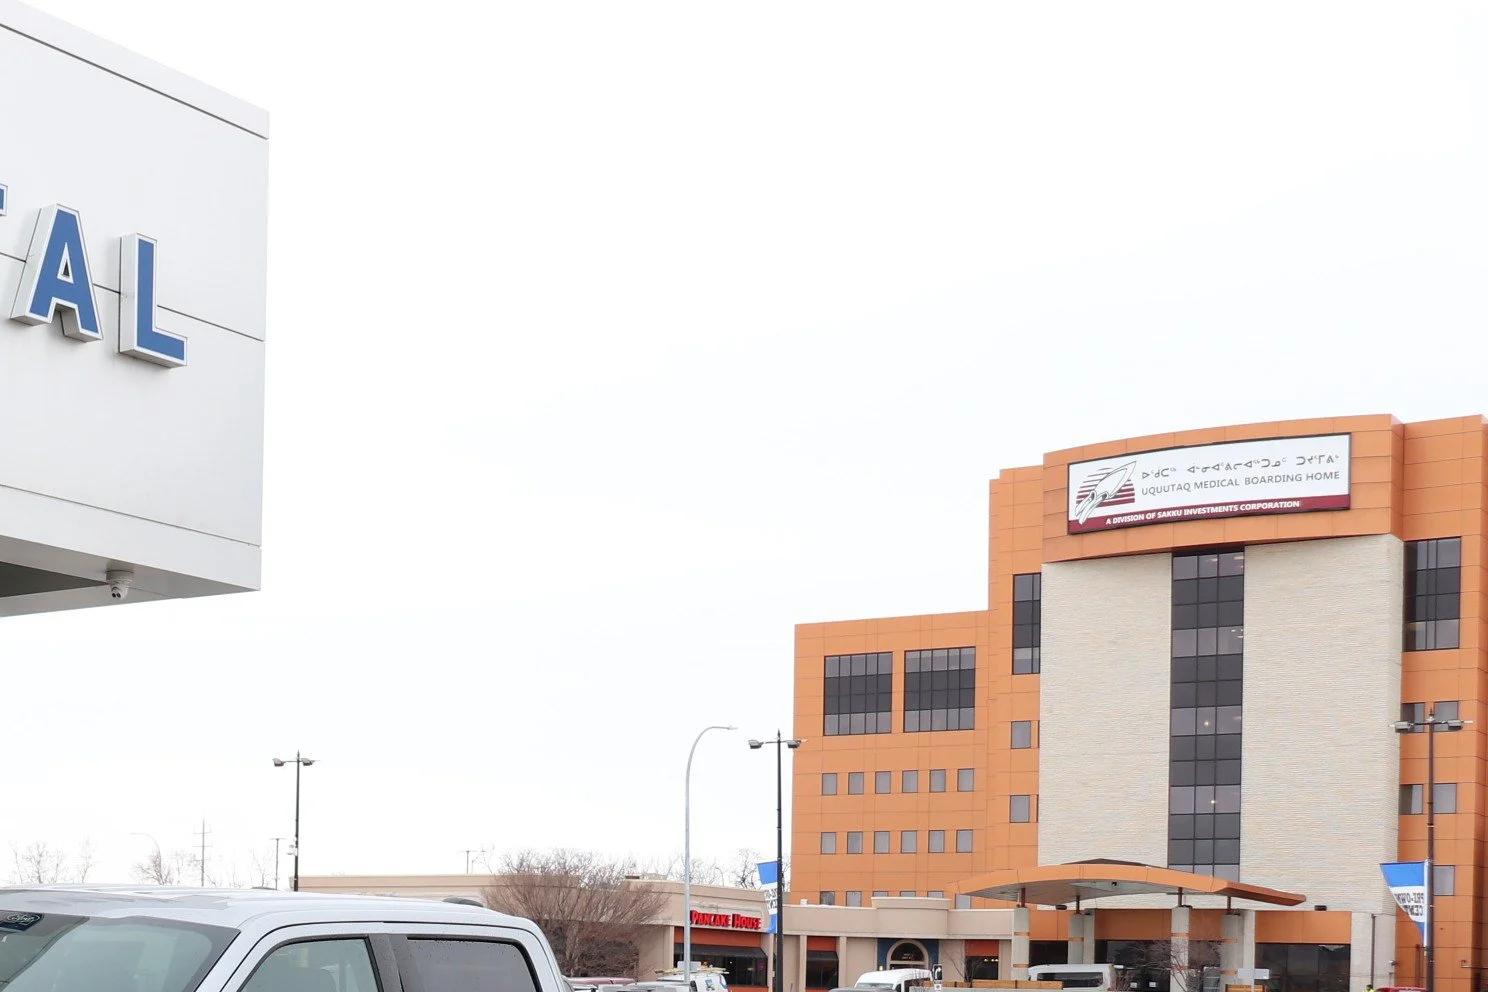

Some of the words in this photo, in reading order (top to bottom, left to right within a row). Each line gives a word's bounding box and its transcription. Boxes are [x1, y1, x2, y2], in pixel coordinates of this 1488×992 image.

[1142, 482, 1191, 496] UQUUTAQ
[1194, 478, 1240, 490] MEDICAL
[1244, 473, 1303, 485] BOARDING
[1306, 471, 1340, 481] HOME
[1112, 515, 1145, 524] DIVISION
[1157, 510, 1183, 519] SAKKU
[1183, 505, 1238, 516] INVESTMENTS
[1239, 500, 1301, 512] CORPORATION
